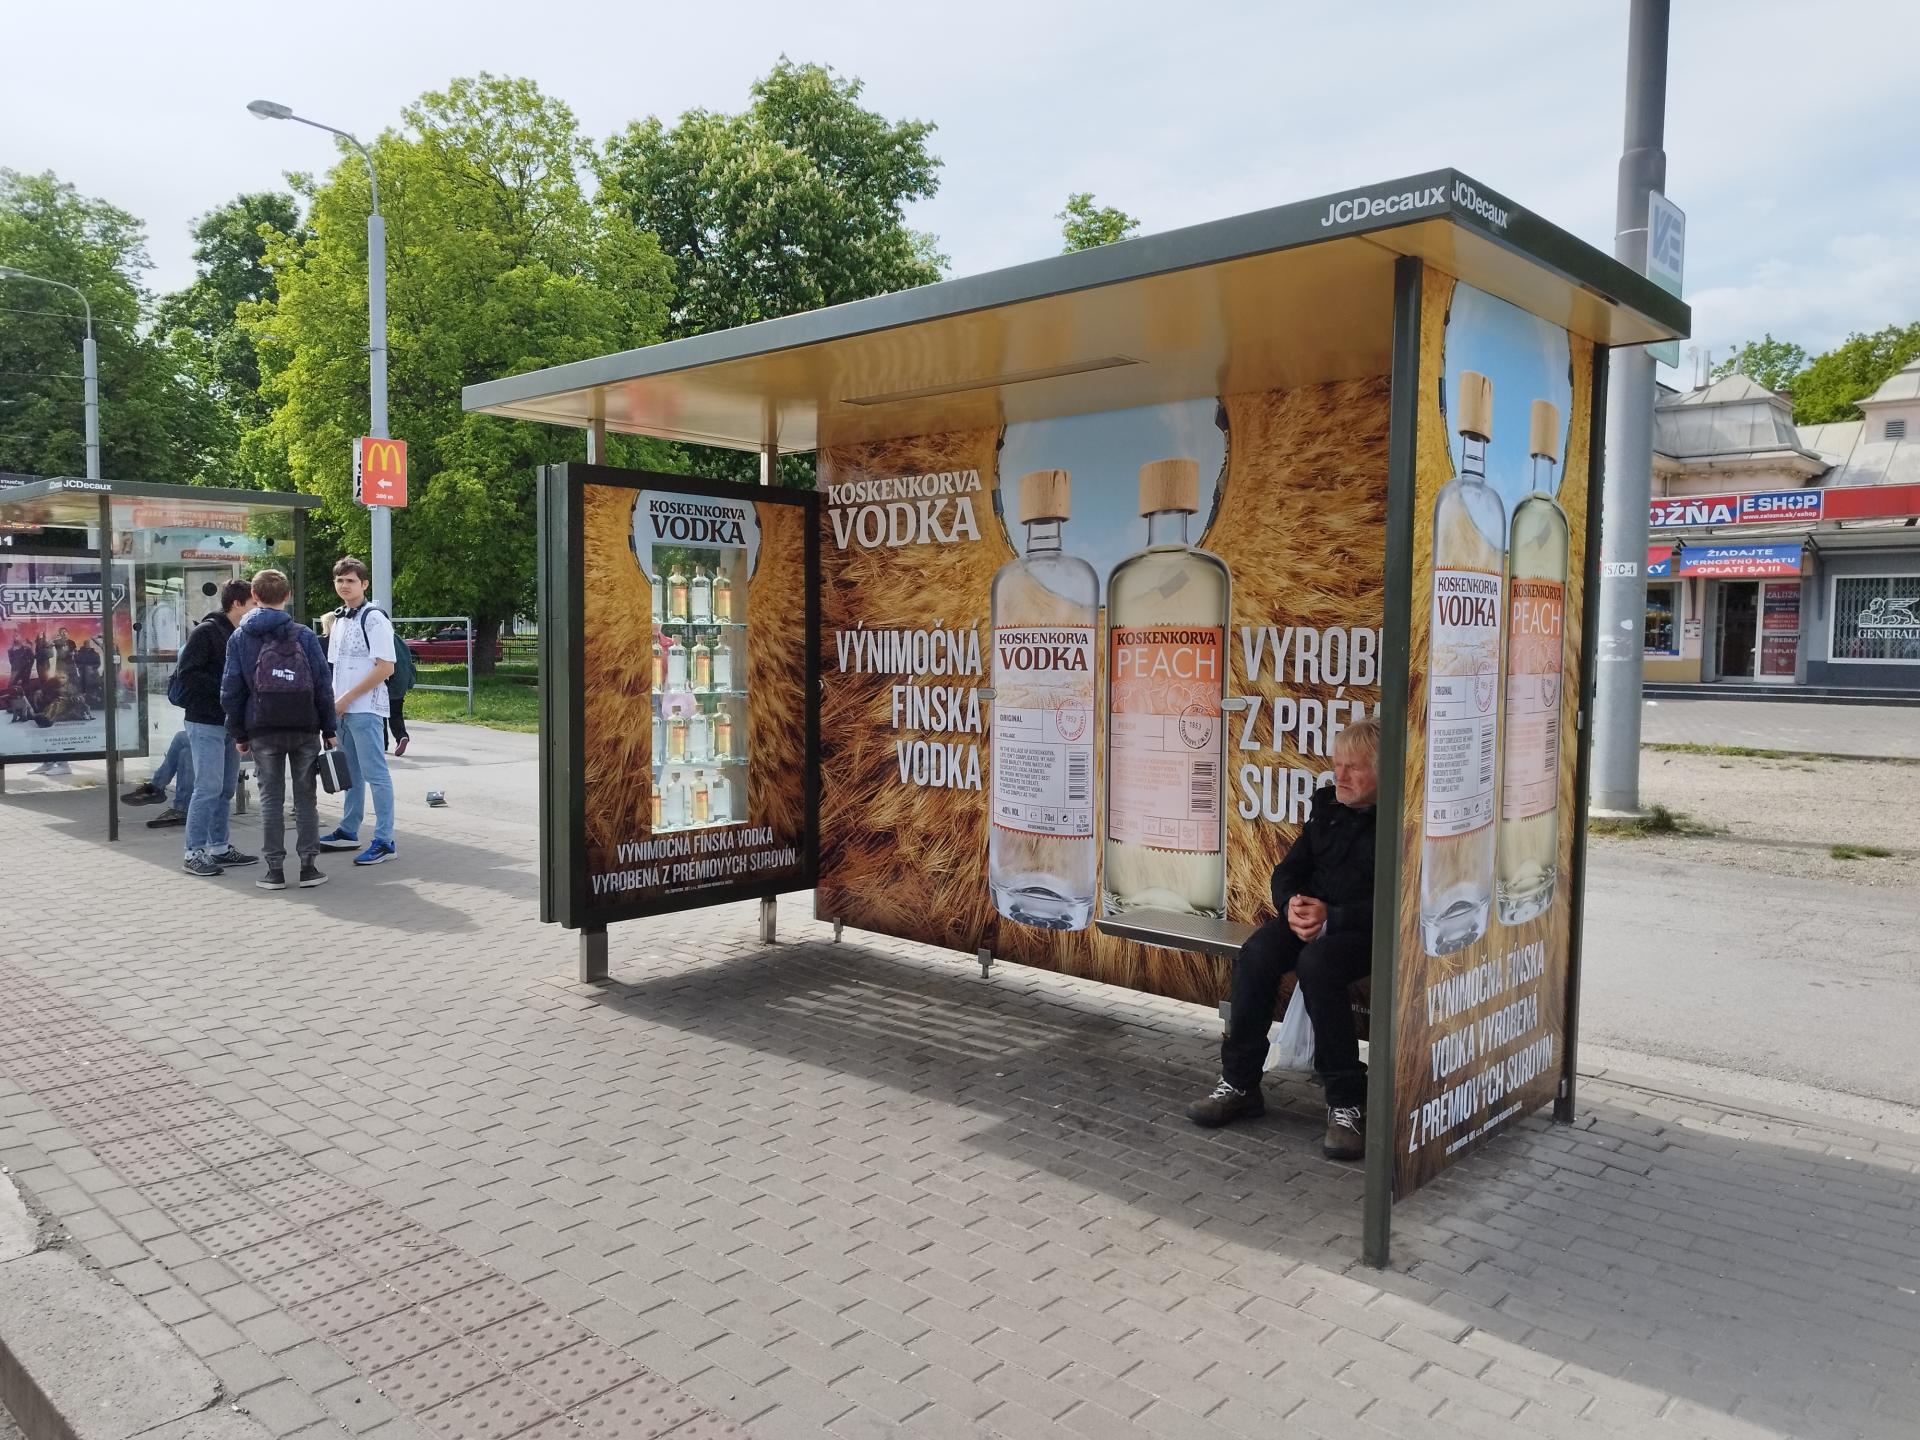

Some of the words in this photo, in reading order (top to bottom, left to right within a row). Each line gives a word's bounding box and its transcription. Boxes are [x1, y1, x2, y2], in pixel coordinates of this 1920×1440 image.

[1321, 186, 1446, 227] JCDecaux
[1451, 180, 1508, 229] JCDecaux
[63, 479, 112, 491] JCDecaux
[827, 469, 982, 506] KOSKENKORVA
[649, 500, 746, 521] KOSKENKORVA
[828, 496, 982, 550] VODKA
[650, 514, 746, 545] VODKA
[1697, 566, 1743, 574] OPLATÍ
[1707, 549, 1773, 557] ŽIADAJTE
[1438, 577, 1498, 595] KOSKENKORVA
[1514, 584, 1562, 600] KOSKENKORVA
[13, 601, 90, 614] GALAXIE
[1437, 596, 1497, 627] VODKA
[1513, 601, 1561, 635] PEACH
[835, 618, 983, 677] VÝNIMOČNÁ
[999, 633, 1088, 645] KOSKENKORVA
[1117, 631, 1216, 646] KOSKENKORVA
[1241, 626, 1383, 686] VYROB
[999, 647, 1088, 671] VODKA
[1117, 647, 1215, 679] PEACH
[892, 675, 983, 735] FÍNSKA
[1239, 695, 1262, 750] Z
[896, 740, 983, 790] VODKA
[617, 834, 691, 864] VÝNIMOČNÁ
[693, 831, 735, 854] FÍNSKA
[736, 826, 774, 848] VODKA
[592, 864, 660, 895] VYROBENÁ
[662, 865, 670, 884] Z
[672, 853, 748, 883] PRÉMIOVÝCH
[750, 844, 796, 871] SUROVÍN
[1427, 947, 1503, 1027] VÝNIMOČNÁ
[1505, 940, 1544, 991] FÍNSKA
[1432, 1023, 1475, 1082] VODKA
[1479, 984, 1538, 1056] VYROBENÁ
[1408, 1107, 1419, 1153] Z
[1422, 1061, 1504, 1146] PRÉMIOVÝCH
[1506, 1031, 1553, 1093] SUROVÍN
